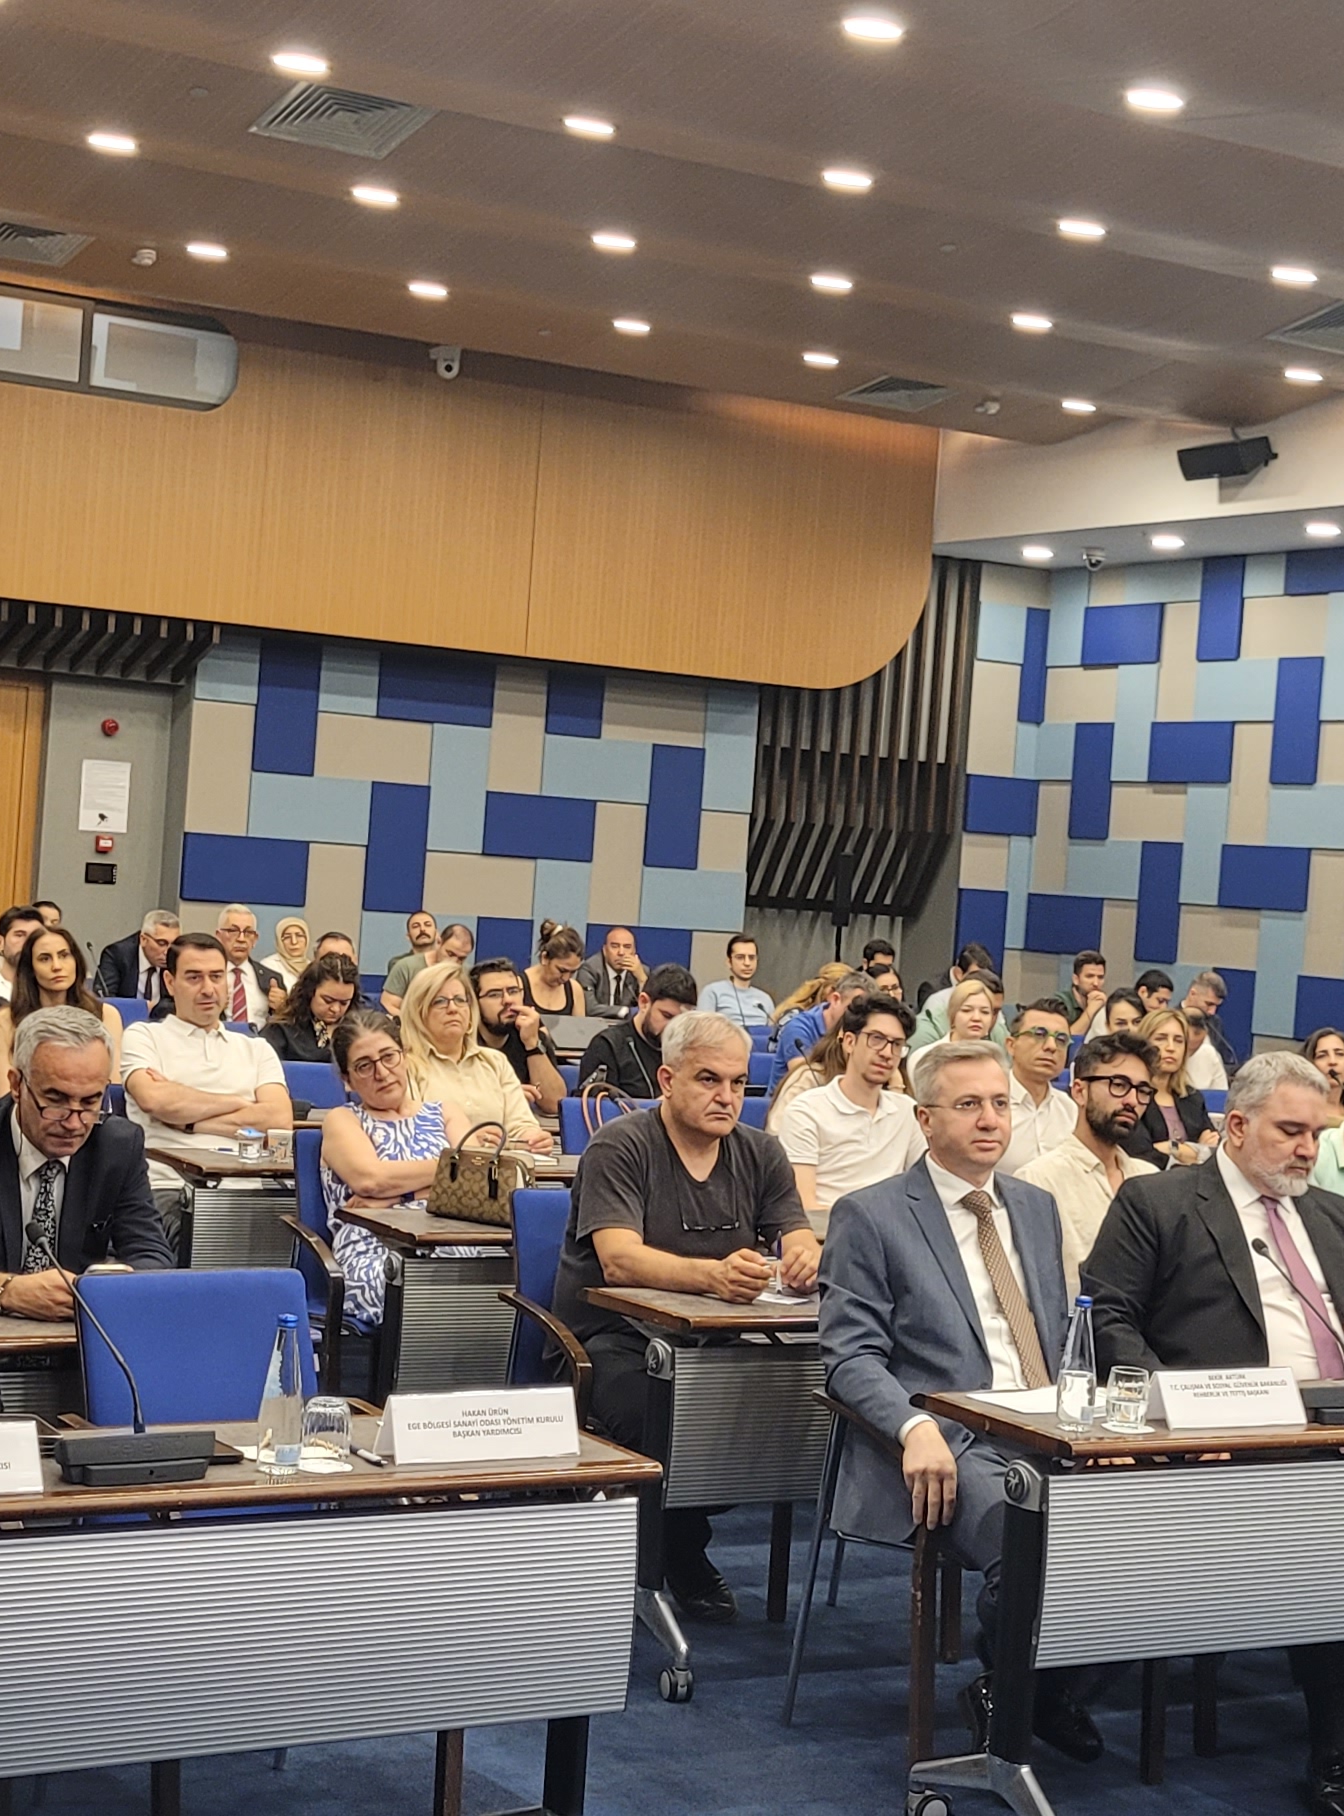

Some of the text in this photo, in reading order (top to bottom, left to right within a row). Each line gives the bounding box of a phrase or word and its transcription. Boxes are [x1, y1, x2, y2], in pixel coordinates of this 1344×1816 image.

[461, 1407, 509, 1417] HAKAN ÜRÜN
[407, 1415, 564, 1430] EGE BÖLGESİ SANAYİ ODASI YÖNETİM KURULU
[452, 1428, 523, 1440] BAŞKAN YARDIMCISI
